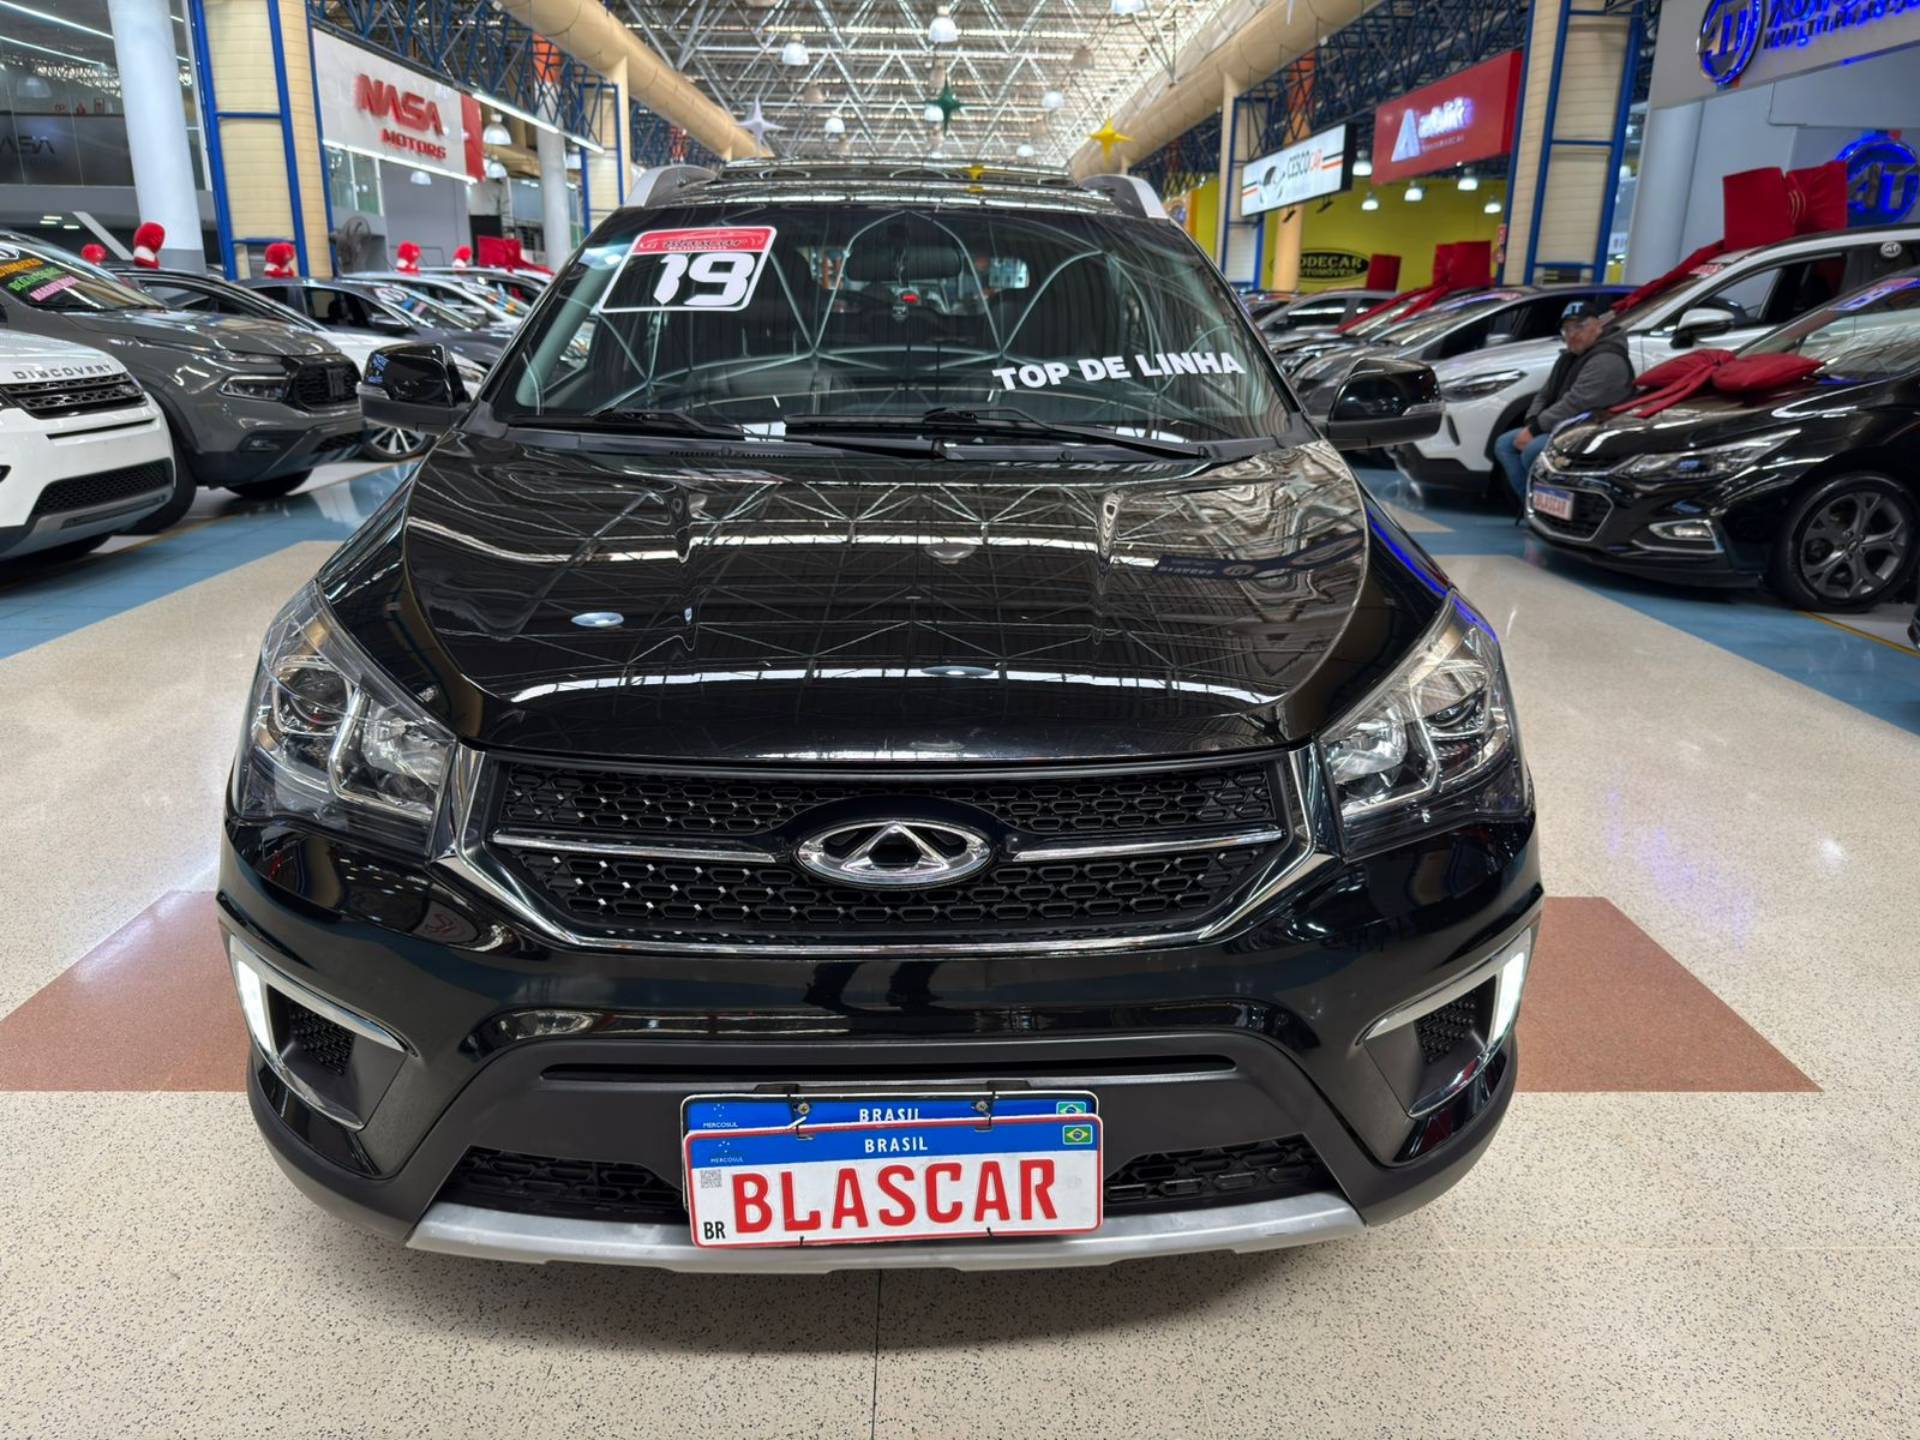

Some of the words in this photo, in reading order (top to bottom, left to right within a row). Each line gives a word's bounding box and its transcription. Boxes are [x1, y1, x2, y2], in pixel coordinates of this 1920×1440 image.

[355, 73, 444, 138] NASA
[381, 128, 447, 159] MOTORS
[653, 253, 756, 306] 19
[12, 364, 113, 380] DISCOVERY
[992, 362, 1070, 391] TOP
[1077, 356, 1132, 382] DE
[1134, 352, 1247, 377] LINHA
[864, 1136, 929, 1153] BRASIL
[732, 1158, 1058, 1233] BLASCAR
[703, 1220, 726, 1240] BR
